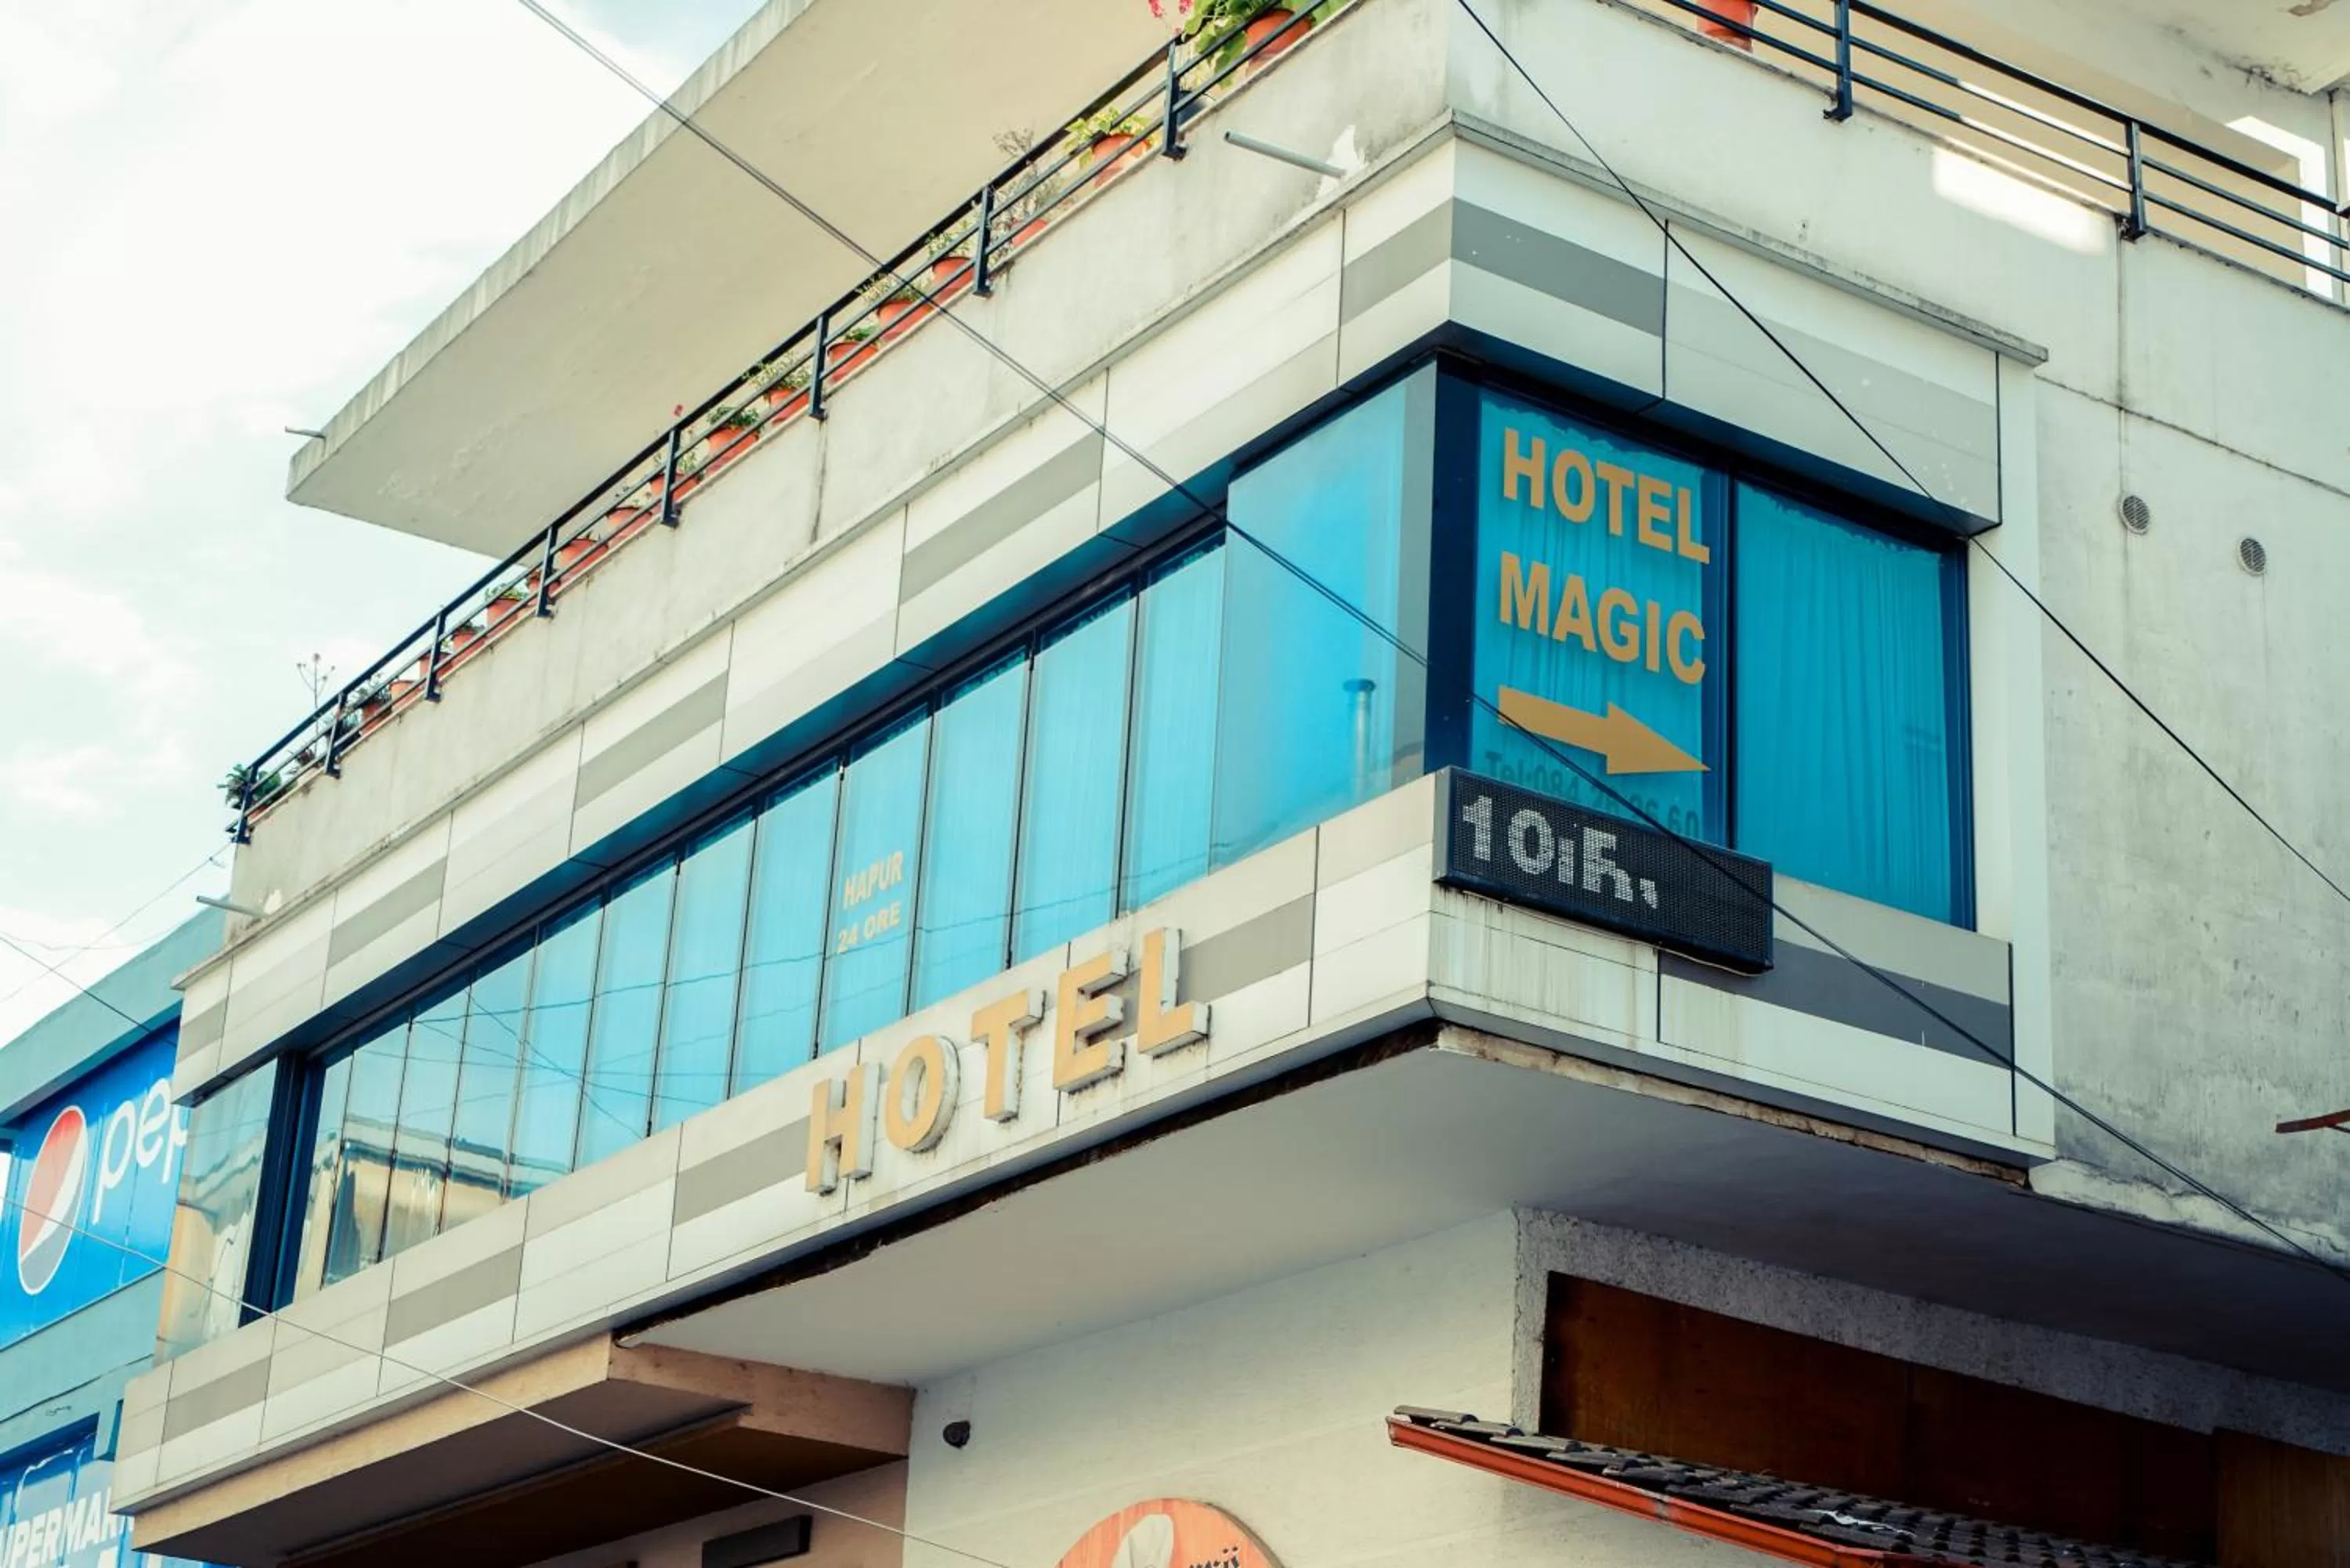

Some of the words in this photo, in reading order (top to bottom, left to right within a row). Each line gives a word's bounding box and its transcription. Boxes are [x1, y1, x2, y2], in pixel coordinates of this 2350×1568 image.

[1503, 427, 1710, 565] HOTEL
[1499, 551, 1705, 685] MAGIC
[838, 923, 859, 954] 24
[864, 901, 901, 941] ORE
[843, 851, 903, 910] HAPUR
[805, 927, 1212, 1195] HOTEL
